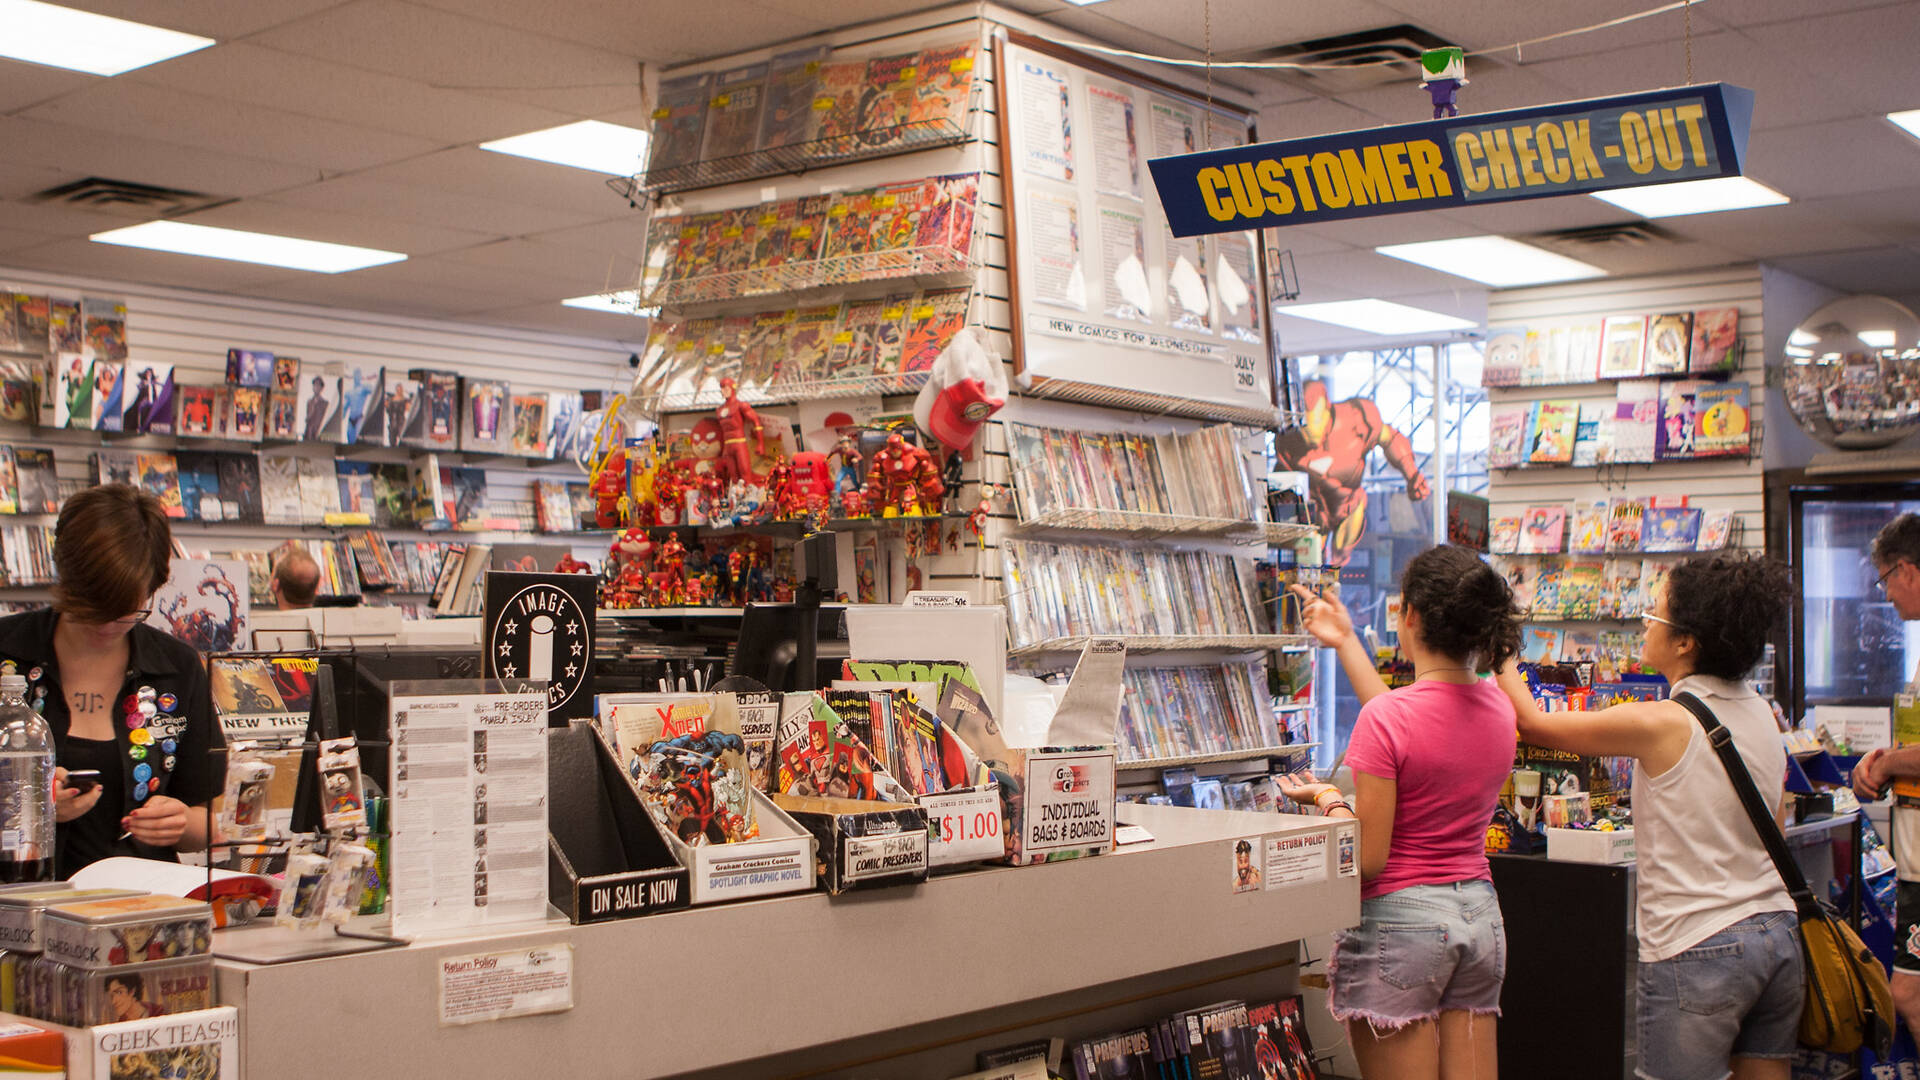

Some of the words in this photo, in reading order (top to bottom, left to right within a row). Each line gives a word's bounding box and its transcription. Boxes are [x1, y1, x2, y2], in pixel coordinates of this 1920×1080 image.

[1196, 139, 1453, 223] CUSTOMER
[1455, 104, 1708, 194] CHECK-OUT
[1050, 319, 1073, 333] NEW
[1078, 325, 1119, 340] COMICS
[1124, 331, 1145, 344] FOR
[1234, 355, 1256, 372] JULY
[1237, 373, 1255, 387] 2ND
[518, 592, 568, 616] IMAGE
[494, 701, 545, 712] PRE-ORDERS
[224, 718, 259, 729] NEW
[1041, 800, 1100, 822] INDIVIDUAL
[943, 811, 998, 845] $1.00
[1032, 823, 1058, 843] BAGS
[1061, 822, 1067, 840] &
[1069, 819, 1105, 839] BOARDS
[1277, 838, 1302, 852] RETURN
[1304, 834, 1327, 848] POLICY
[715, 863, 742, 872] Graham
[743, 860, 771, 869] Crackers
[772, 857, 794, 866] Comics
[855, 857, 880, 872] COMIC
[882, 851, 923, 868] PRESERVERS
[709, 873, 748, 890] SPOTLIGHT
[749, 871, 779, 886] GRAPHIC
[780, 869, 802, 881] NOVEL
[591, 888, 611, 914] ON
[615, 882, 645, 910] SALE
[650, 878, 679, 905] NOW
[0, 926, 35, 944] ERLOCK
[47, 937, 101, 962] SHERLOCK
[444, 961, 472, 974] Return
[474, 956, 499, 970] Policy
[1202, 1006, 1249, 1036] PREVIEWS
[100, 1030, 161, 1053] GEEK
[166, 1018, 238, 1046] TEAS!!!
[1093, 1031, 1151, 1065] PREVIEWS
